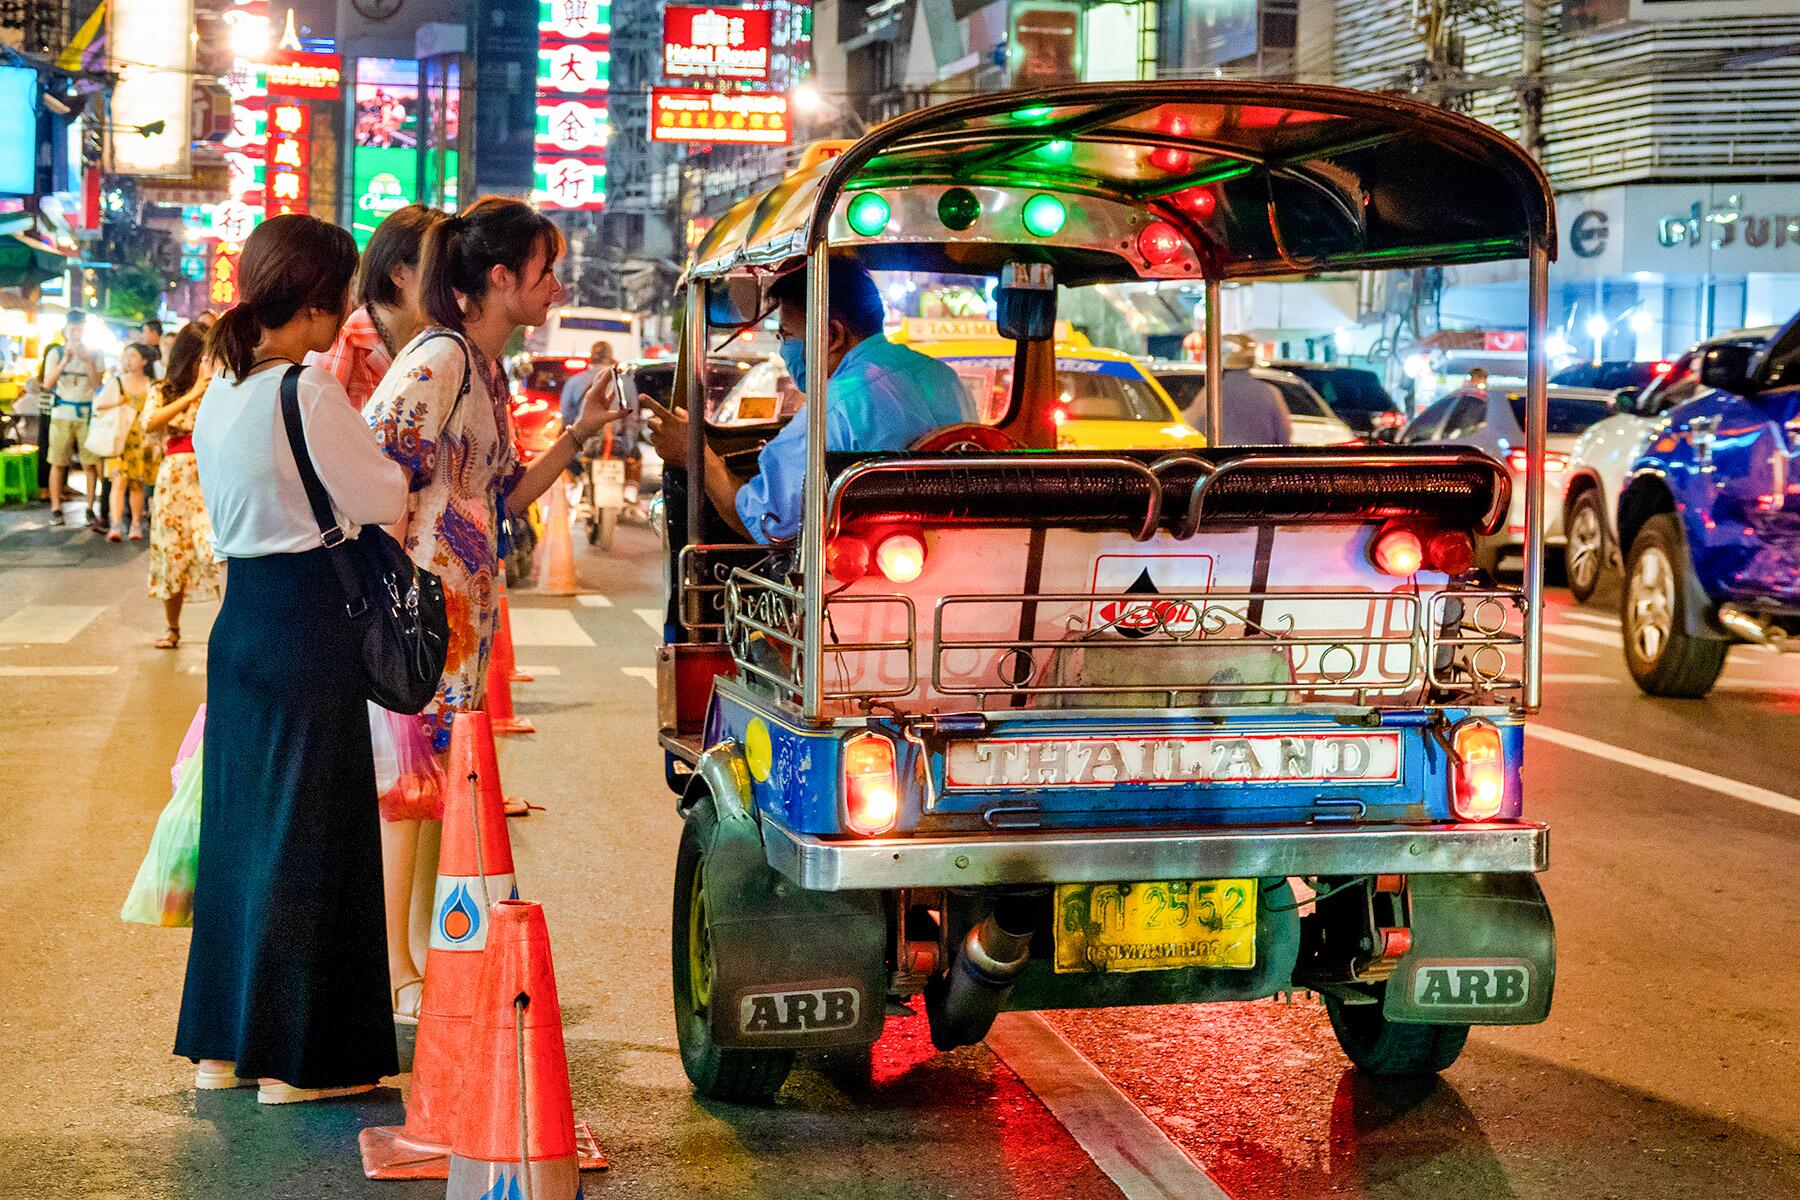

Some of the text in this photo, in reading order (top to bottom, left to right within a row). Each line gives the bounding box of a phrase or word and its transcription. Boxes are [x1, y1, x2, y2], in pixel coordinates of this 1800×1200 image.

[976, 737, 1373, 785] THAILAND
[1143, 883, 1247, 930] 2552
[1419, 969, 1525, 1004] ARB
[745, 990, 856, 1032] ARB
